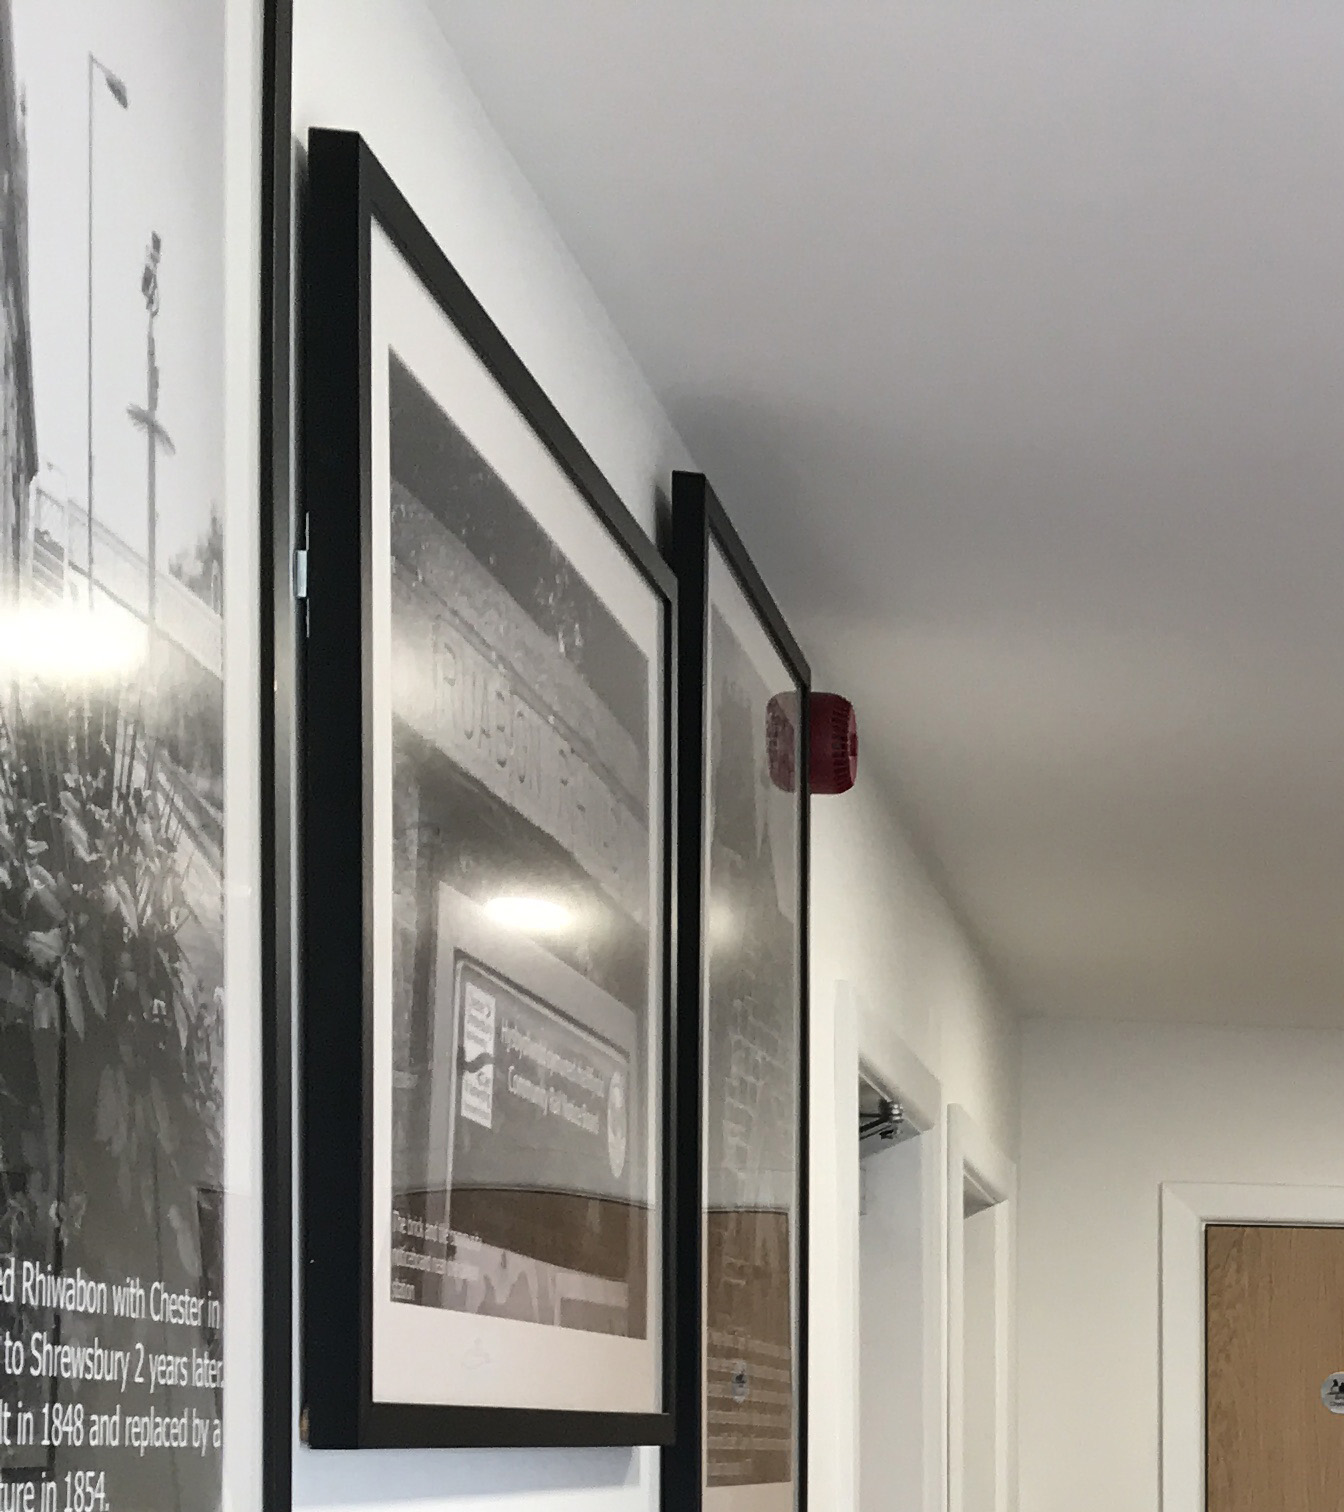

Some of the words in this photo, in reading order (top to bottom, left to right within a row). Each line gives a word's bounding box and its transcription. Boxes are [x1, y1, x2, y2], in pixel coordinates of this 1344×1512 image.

[22, 1260, 107, 1315] Rhiwabon
[112, 1276, 146, 1319] with
[150, 1281, 204, 1326] Chester
[207, 1290, 220, 1329] in
[4, 1331, 24, 1375] to
[30, 1331, 131, 1393] Shrewsbury
[134, 1343, 144, 1383] 2
[149, 1353, 187, 1393] years
[17, 1401, 33, 1446] in
[41, 1403, 84, 1447] 1848
[89, 1404, 120, 1447] and
[125, 1406, 187, 1457] replaced
[192, 1408, 210, 1457] by
[213, 1418, 221, 1448] a
